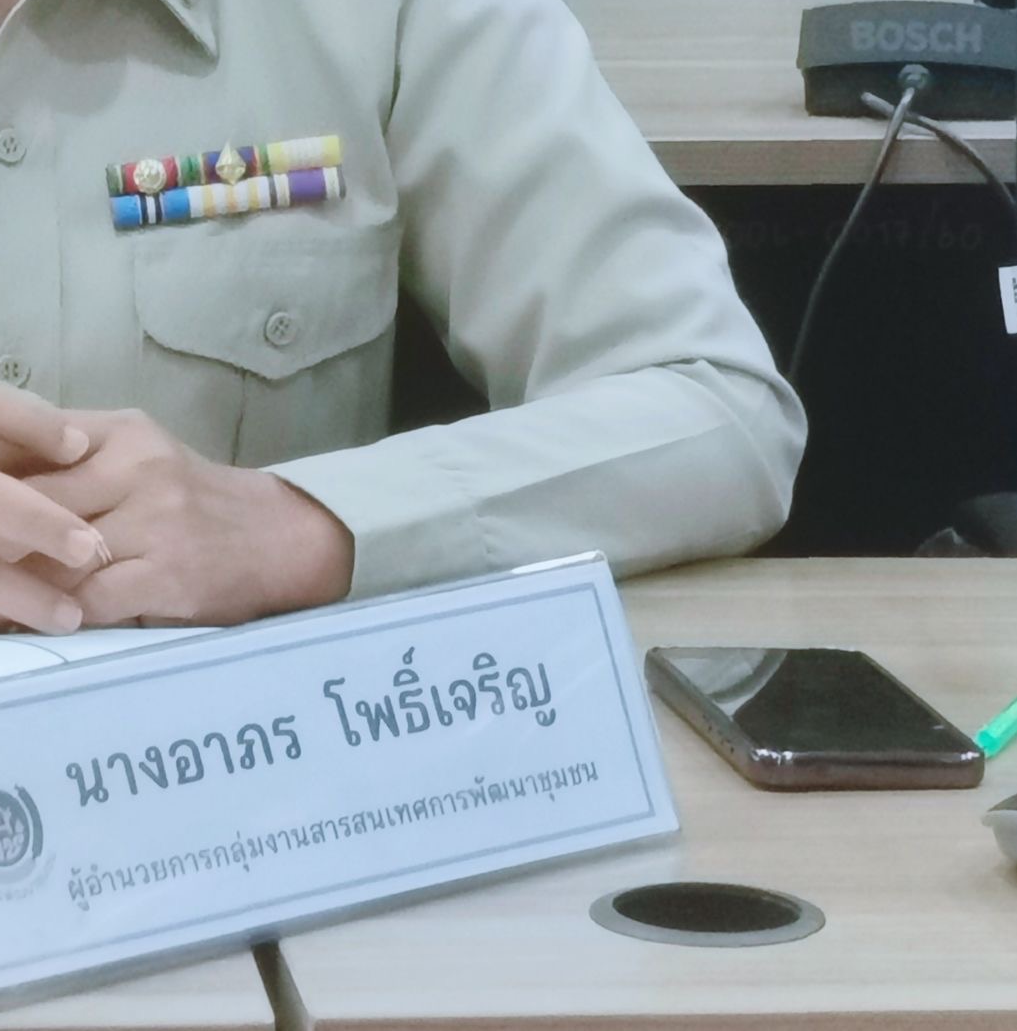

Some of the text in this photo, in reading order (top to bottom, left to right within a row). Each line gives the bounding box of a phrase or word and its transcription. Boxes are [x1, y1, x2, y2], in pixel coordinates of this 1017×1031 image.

[849, 20, 982, 53] BOSCH
[66, 646, 556, 807] นางอาภร โพธิ์เจริญ
